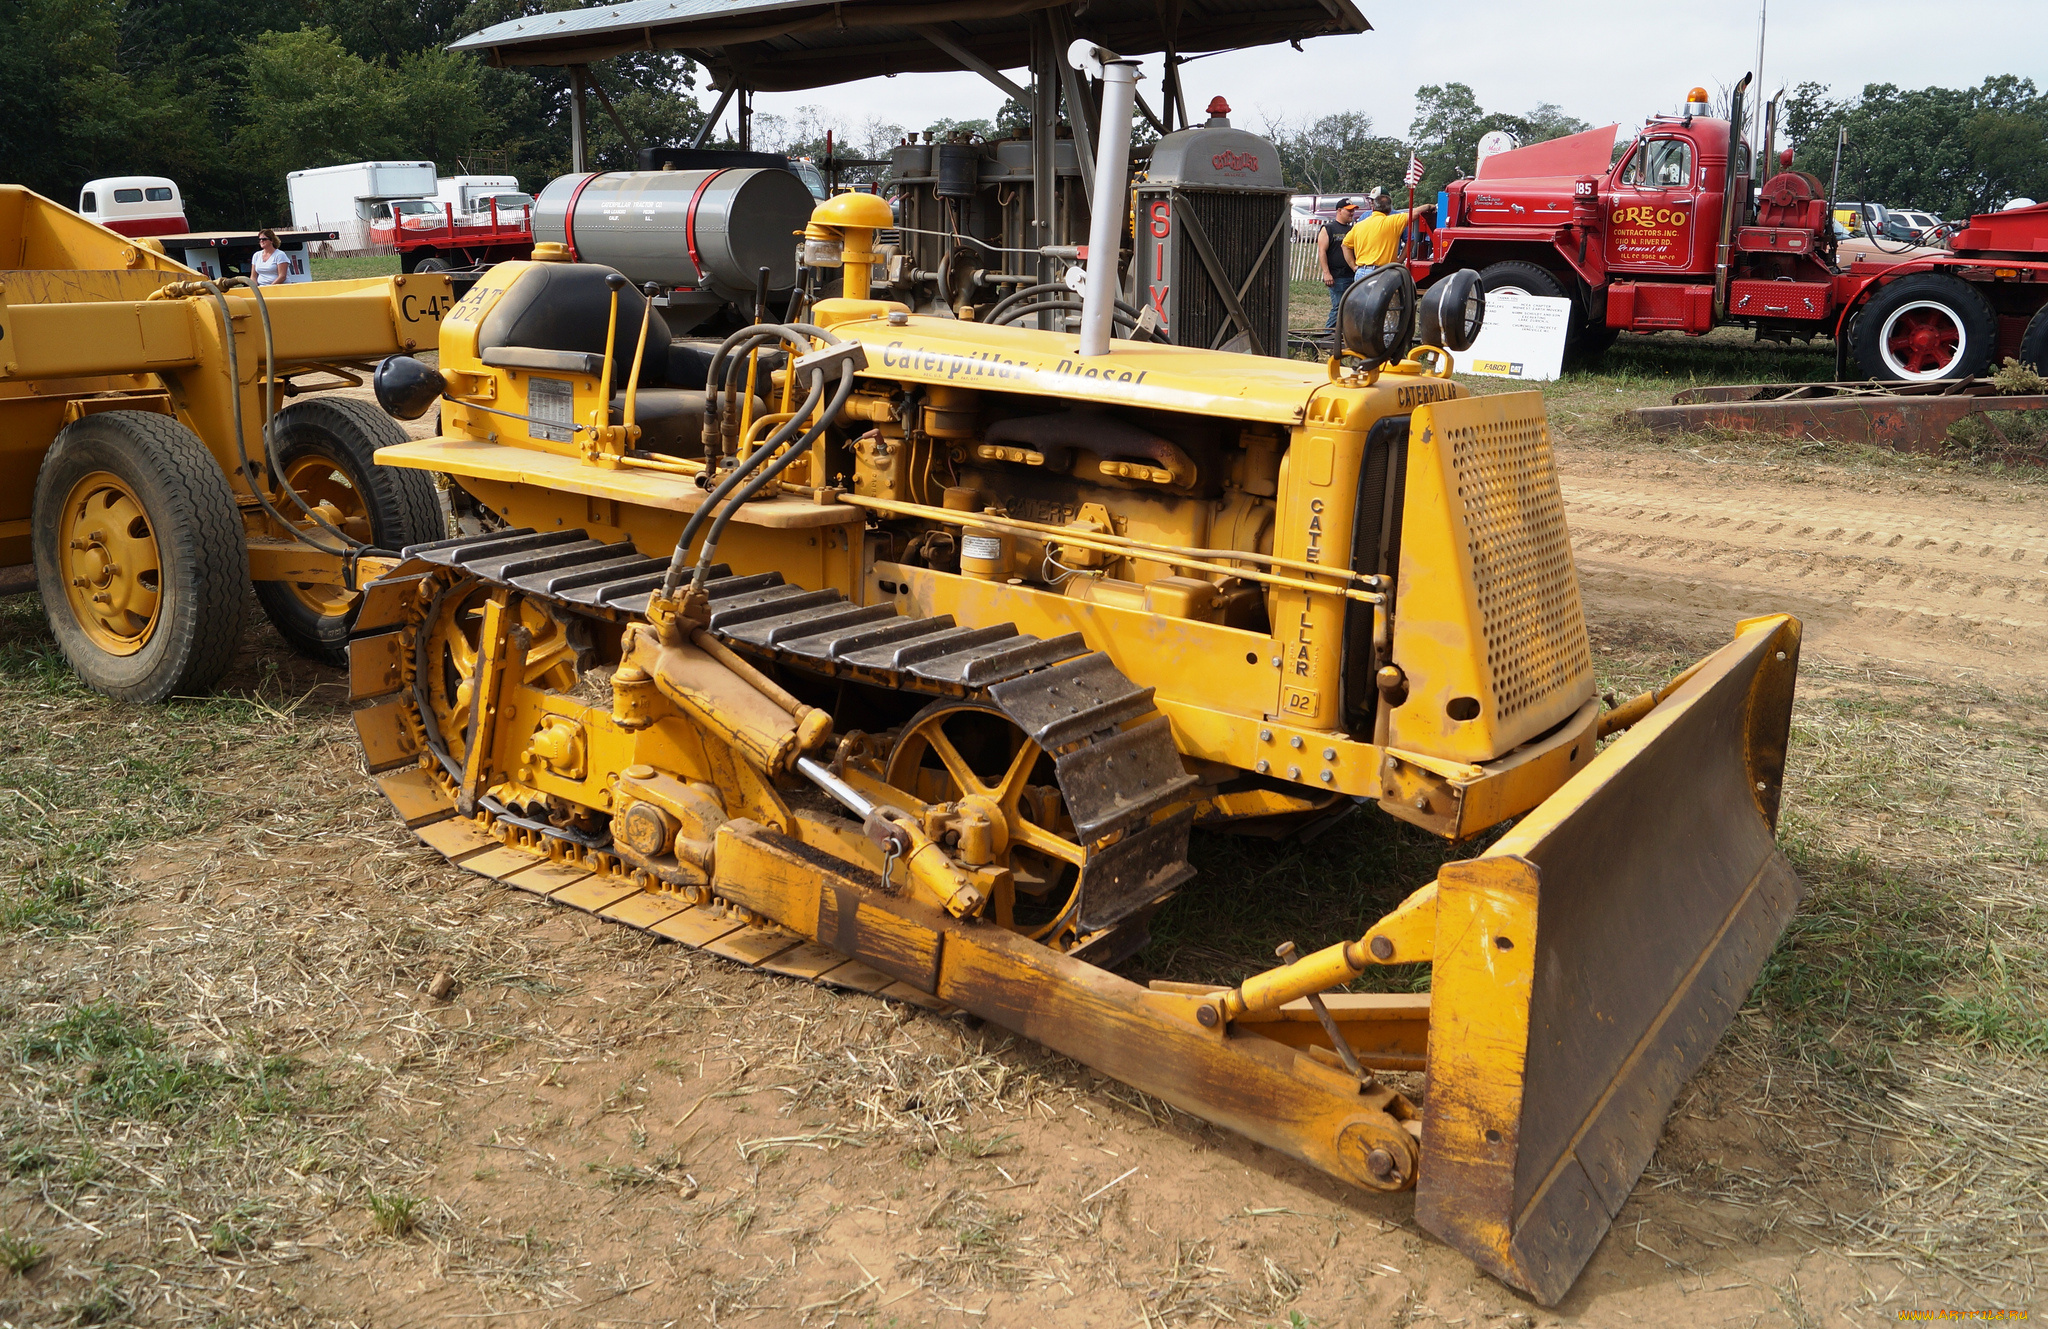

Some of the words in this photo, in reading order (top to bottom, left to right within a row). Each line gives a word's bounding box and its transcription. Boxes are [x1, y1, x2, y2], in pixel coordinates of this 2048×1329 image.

[1212, 150, 1259, 172] CATERPILLAR
[1575, 182, 1592, 195] 185
[1612, 206, 1686, 228] GRECO
[460, 286, 504, 305] CAT
[402, 294, 451, 323] C-45
[452, 305, 479, 322] D2
[883, 341, 1029, 381] Caterpillar
[1055, 359, 1149, 387] Diesel
[1484, 363, 1507, 372] FABCO
[1397, 382, 1457, 407] CATERPILLAR
[1290, 693, 1309, 710] D2
